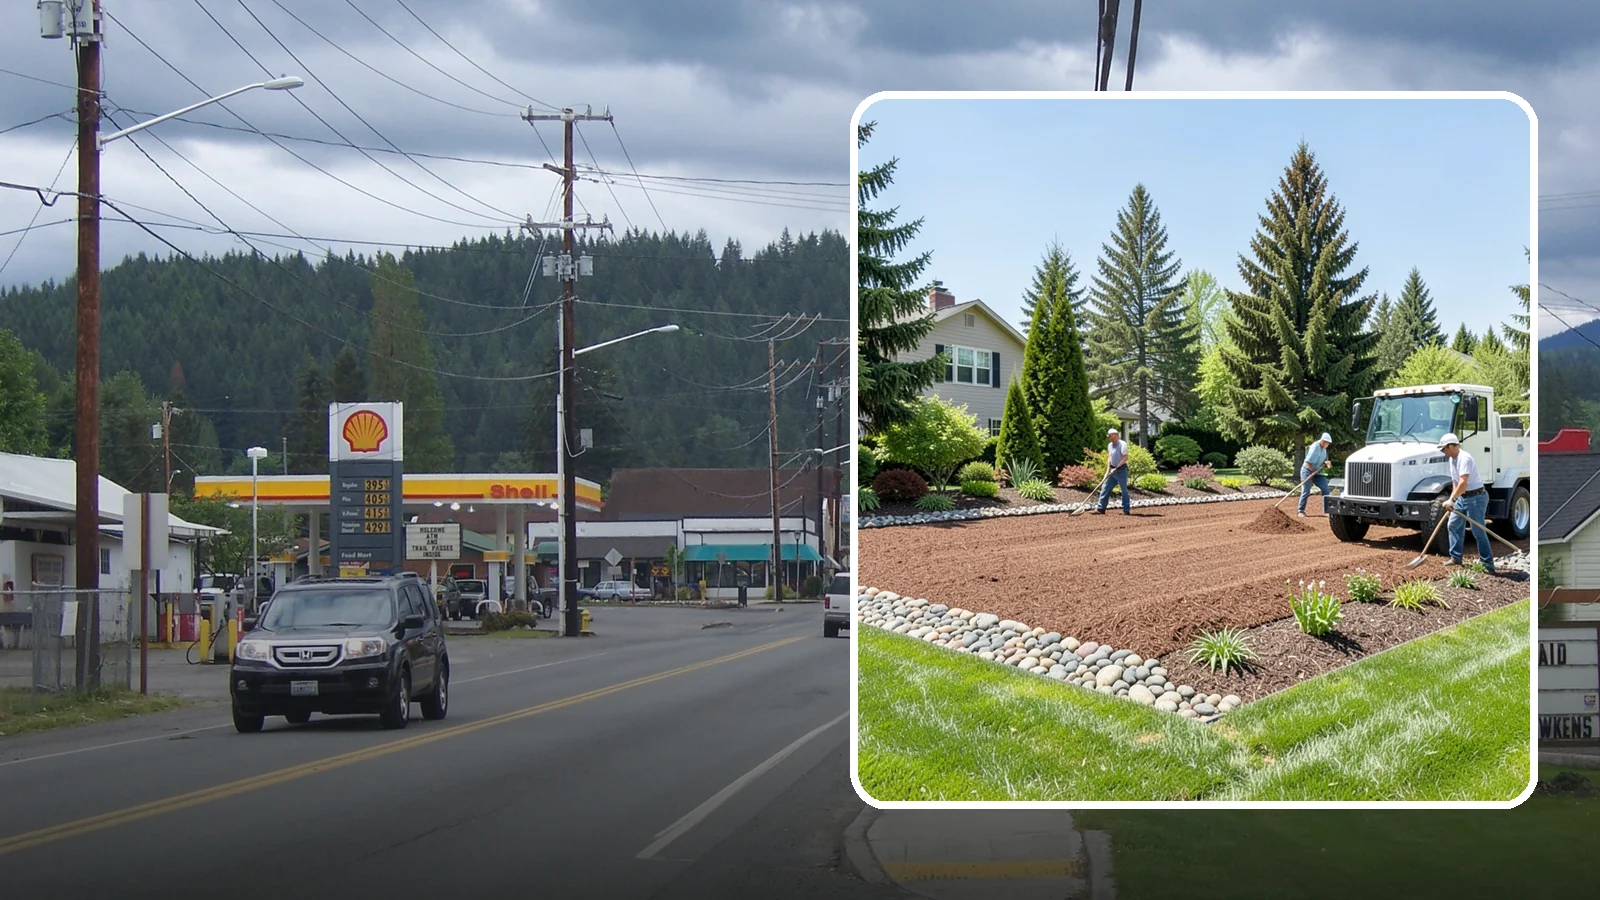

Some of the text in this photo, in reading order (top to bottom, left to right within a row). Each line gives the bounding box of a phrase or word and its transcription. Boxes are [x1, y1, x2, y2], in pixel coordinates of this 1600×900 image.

[365, 479, 383, 490] 395
[490, 484, 547, 499] Shell
[365, 494, 383, 504] 405
[365, 508, 383, 518] 415
[365, 522, 383, 533] 429
